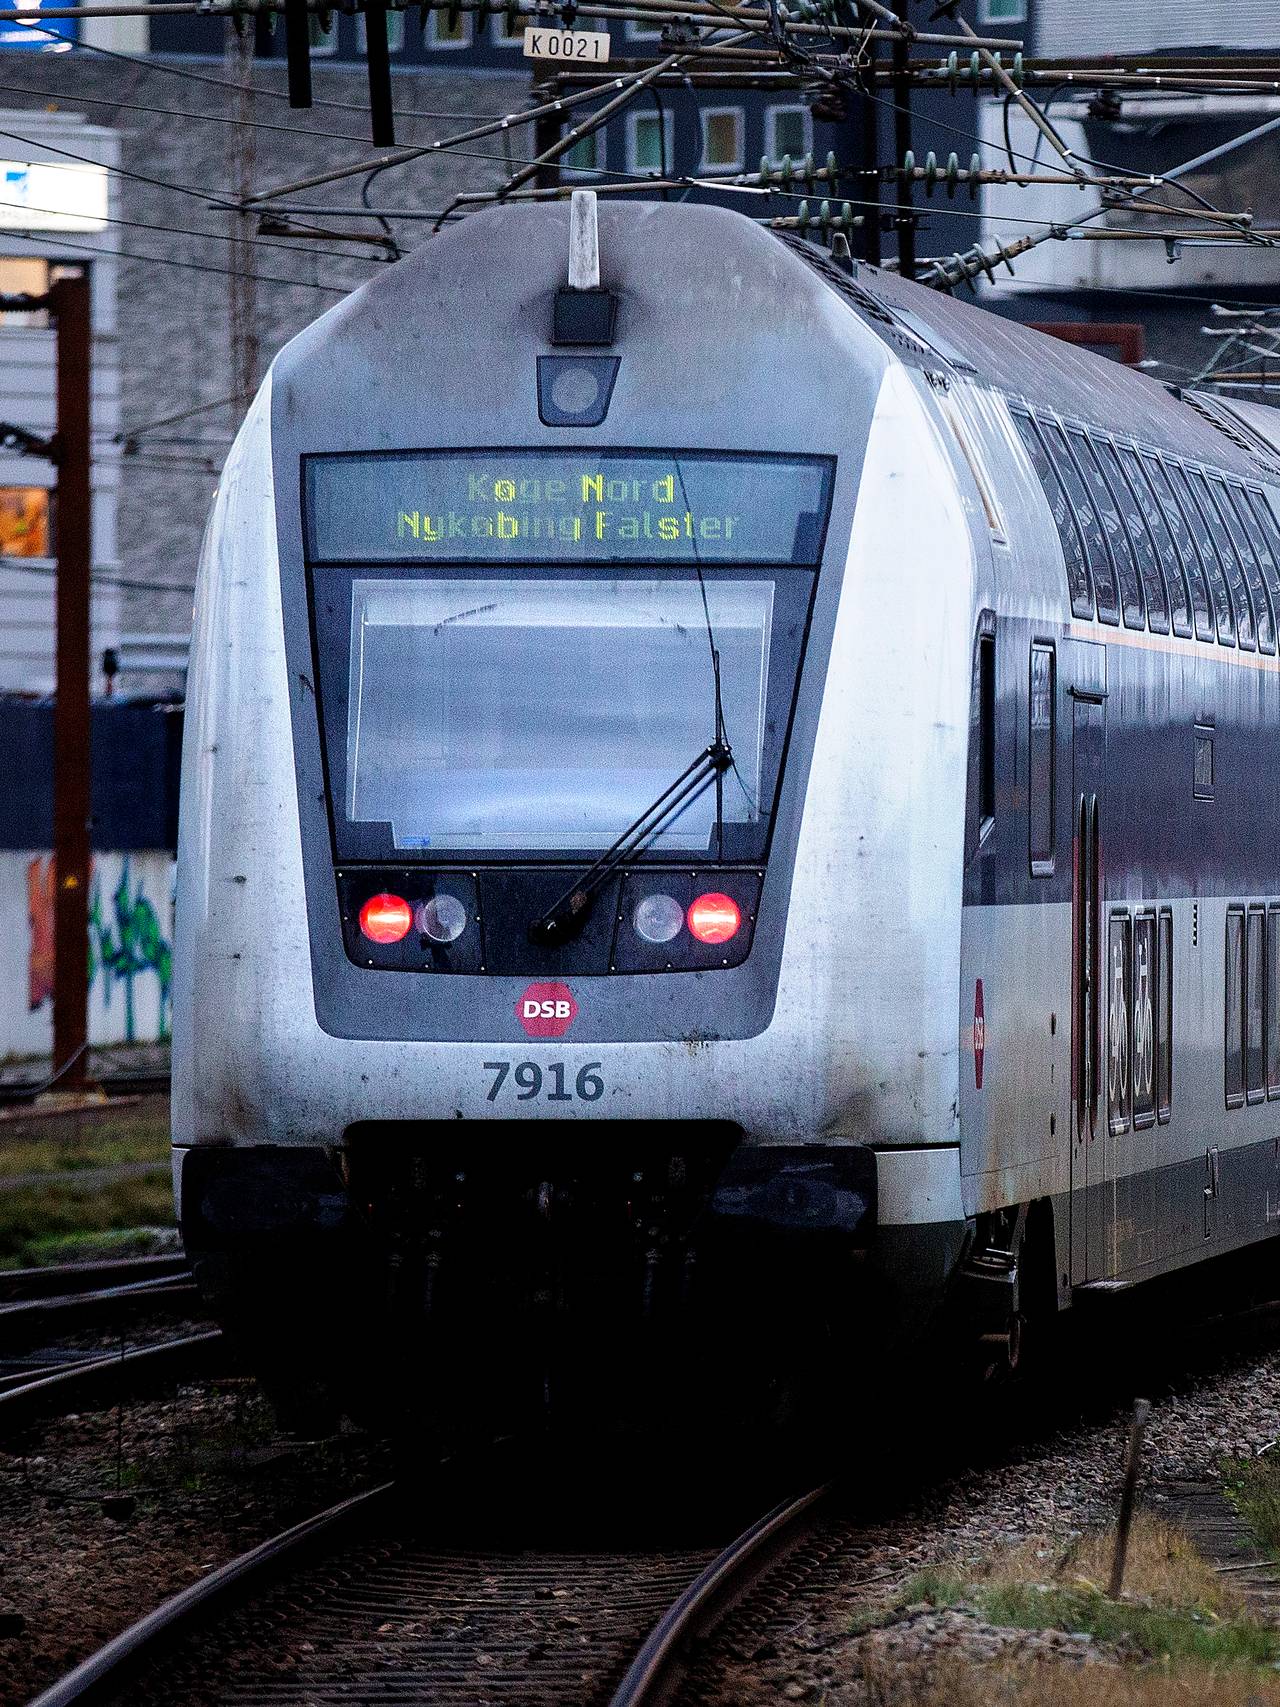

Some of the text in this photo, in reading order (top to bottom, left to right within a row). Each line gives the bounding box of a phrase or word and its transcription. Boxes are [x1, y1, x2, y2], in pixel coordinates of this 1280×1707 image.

[581, 474, 674, 503] Nord
[397, 511, 741, 542] Nykøbing Falster
[523, 1000, 571, 1019] DSB
[483, 1061, 605, 1101] 7916
